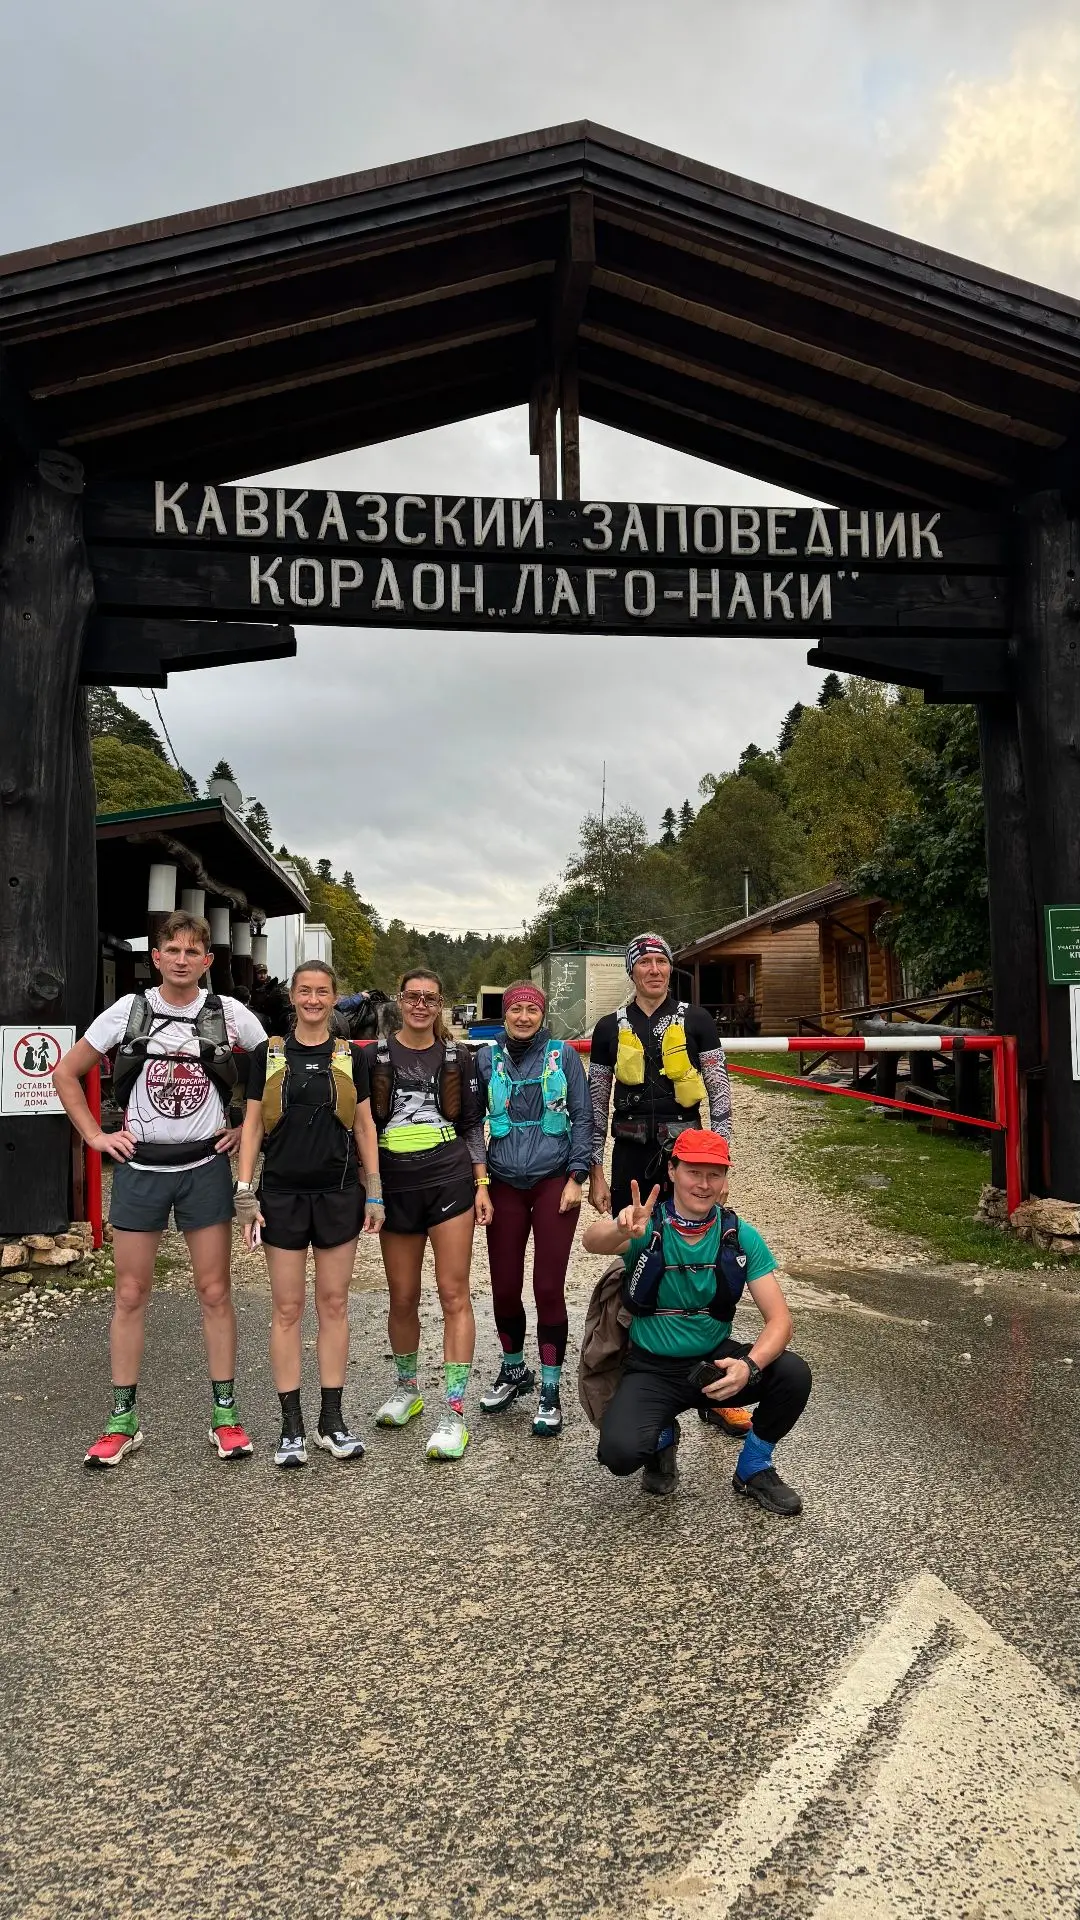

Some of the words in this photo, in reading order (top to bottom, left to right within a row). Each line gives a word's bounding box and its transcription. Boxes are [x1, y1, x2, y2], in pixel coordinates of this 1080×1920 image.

[154, 480, 544, 549] КАВКАЗСКИЙ
[582, 502, 943, 559] ЗАПОВЕДНИК
[249, 555, 485, 614] КОРДОН
[24, 1099, 48, 1107] ДОМА
